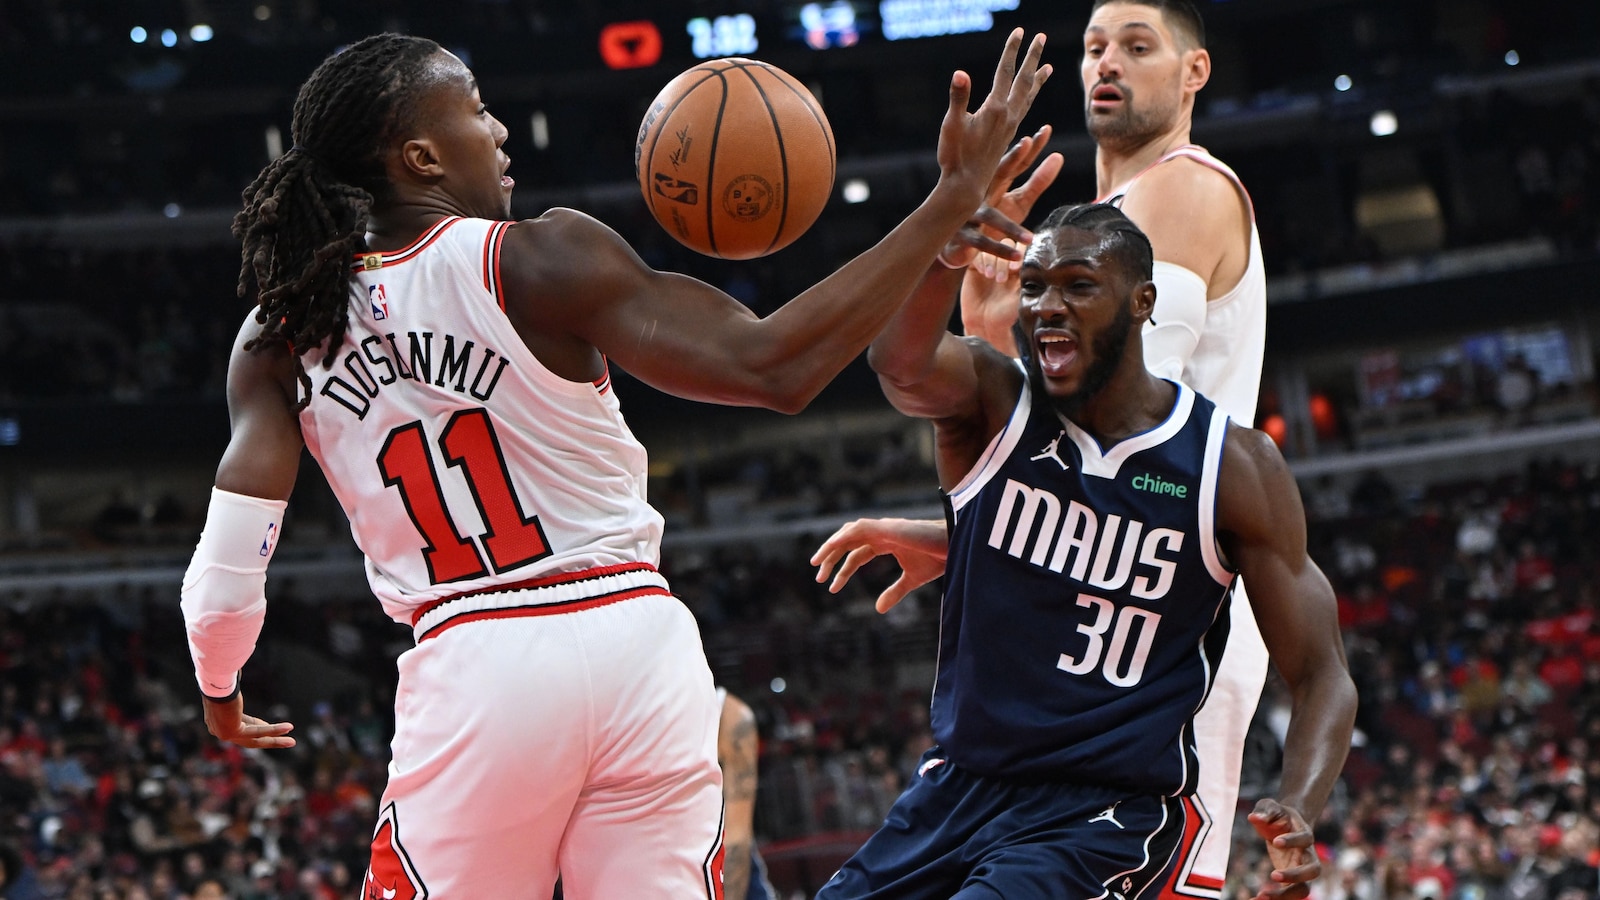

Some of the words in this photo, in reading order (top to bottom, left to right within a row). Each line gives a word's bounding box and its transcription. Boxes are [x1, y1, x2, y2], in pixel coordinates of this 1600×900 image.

[376, 407, 553, 586] 11
[987, 478, 1185, 600] MAVS
[1131, 473, 1187, 498] chime
[1056, 593, 1162, 688] 30
